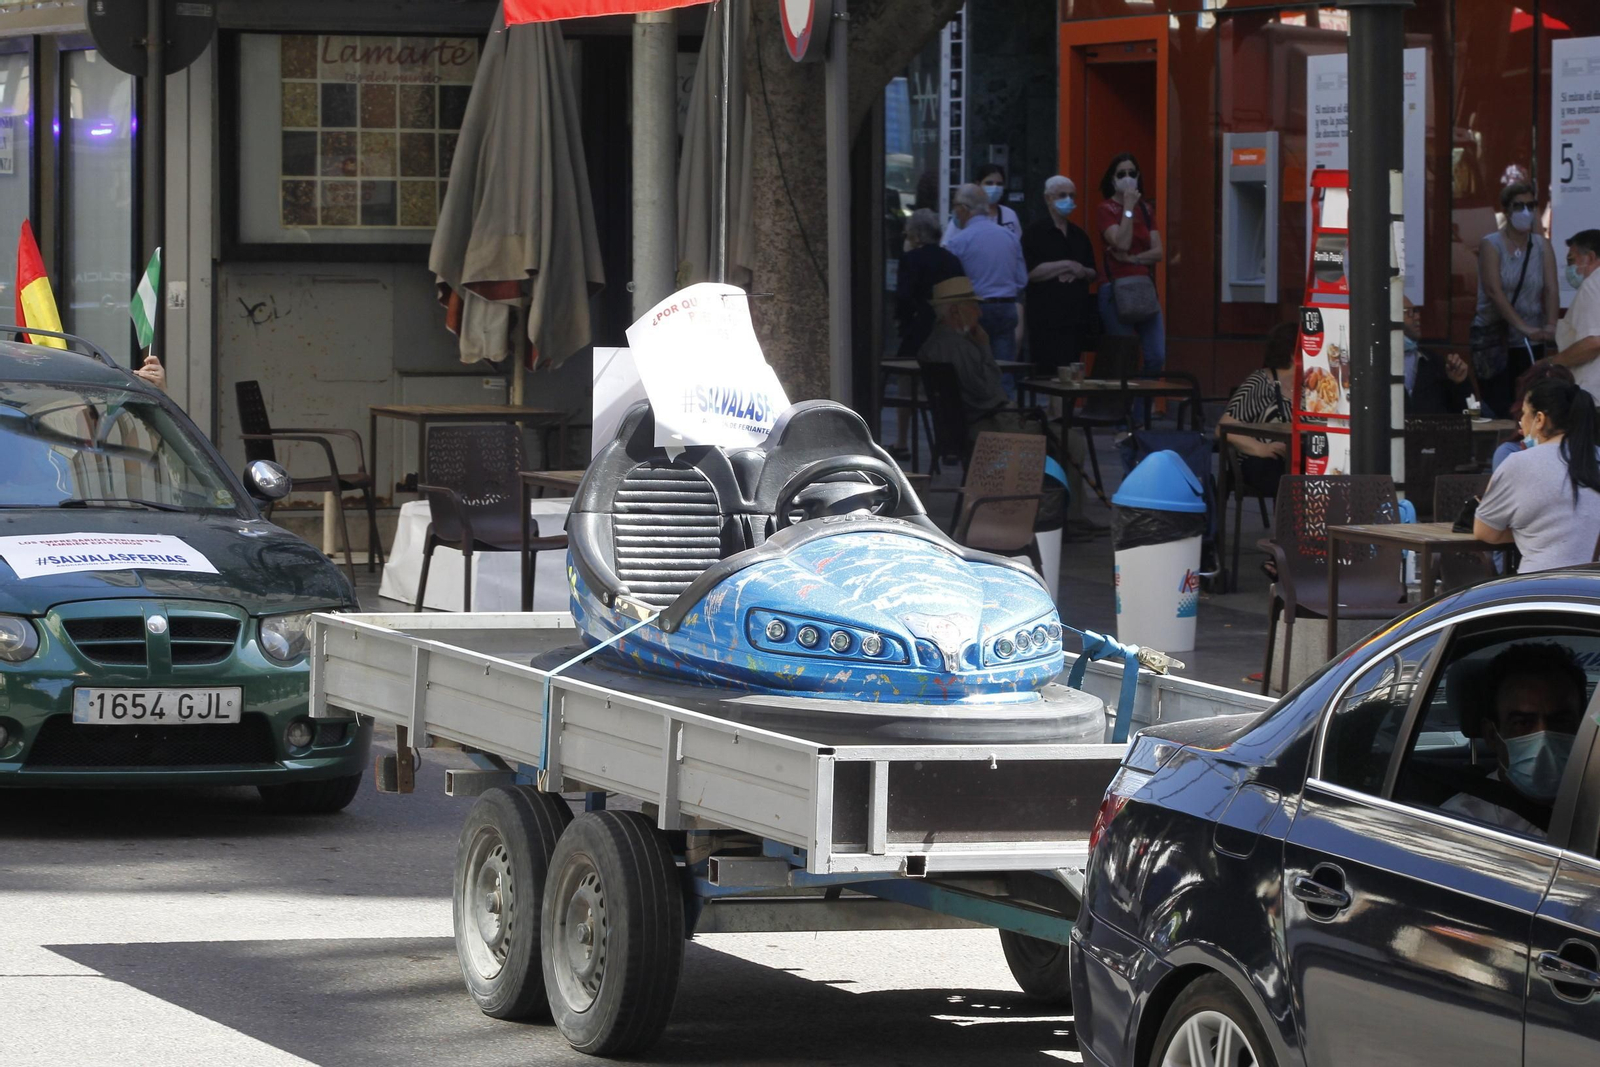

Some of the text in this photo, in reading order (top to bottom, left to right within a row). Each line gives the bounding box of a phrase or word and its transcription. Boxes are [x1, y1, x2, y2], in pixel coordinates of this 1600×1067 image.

[321, 36, 475, 66] Lamarté
[1560, 142, 1574, 184] 5
[652, 304, 679, 326] ¿POR
[681, 297, 699, 309] QU
[682, 385, 780, 423] #SALVALASF
[738, 423, 771, 435] FERIANTE
[39, 537, 106, 545] EMPRESARIOS
[35, 553, 188, 566] #SALVALASFERIAS
[97, 692, 230, 720] 1654 GJL
